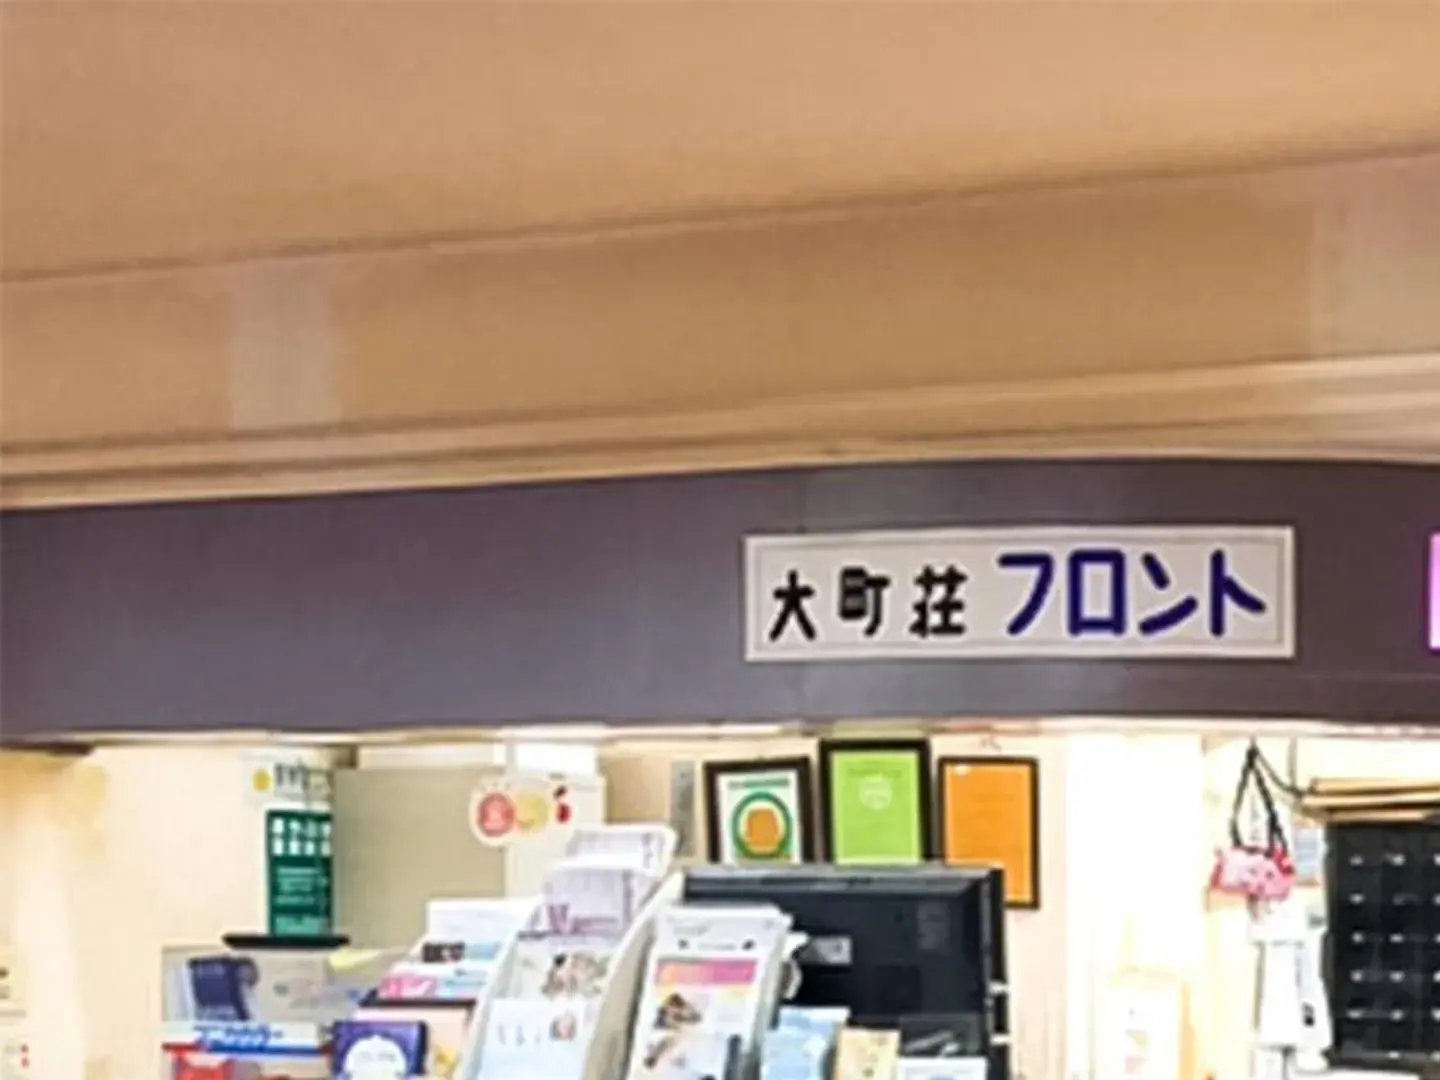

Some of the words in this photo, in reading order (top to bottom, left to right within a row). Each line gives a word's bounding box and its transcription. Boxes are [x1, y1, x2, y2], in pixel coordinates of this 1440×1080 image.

[768, 564, 968, 640] 大町荘
[997, 549, 1266, 637] フロント
